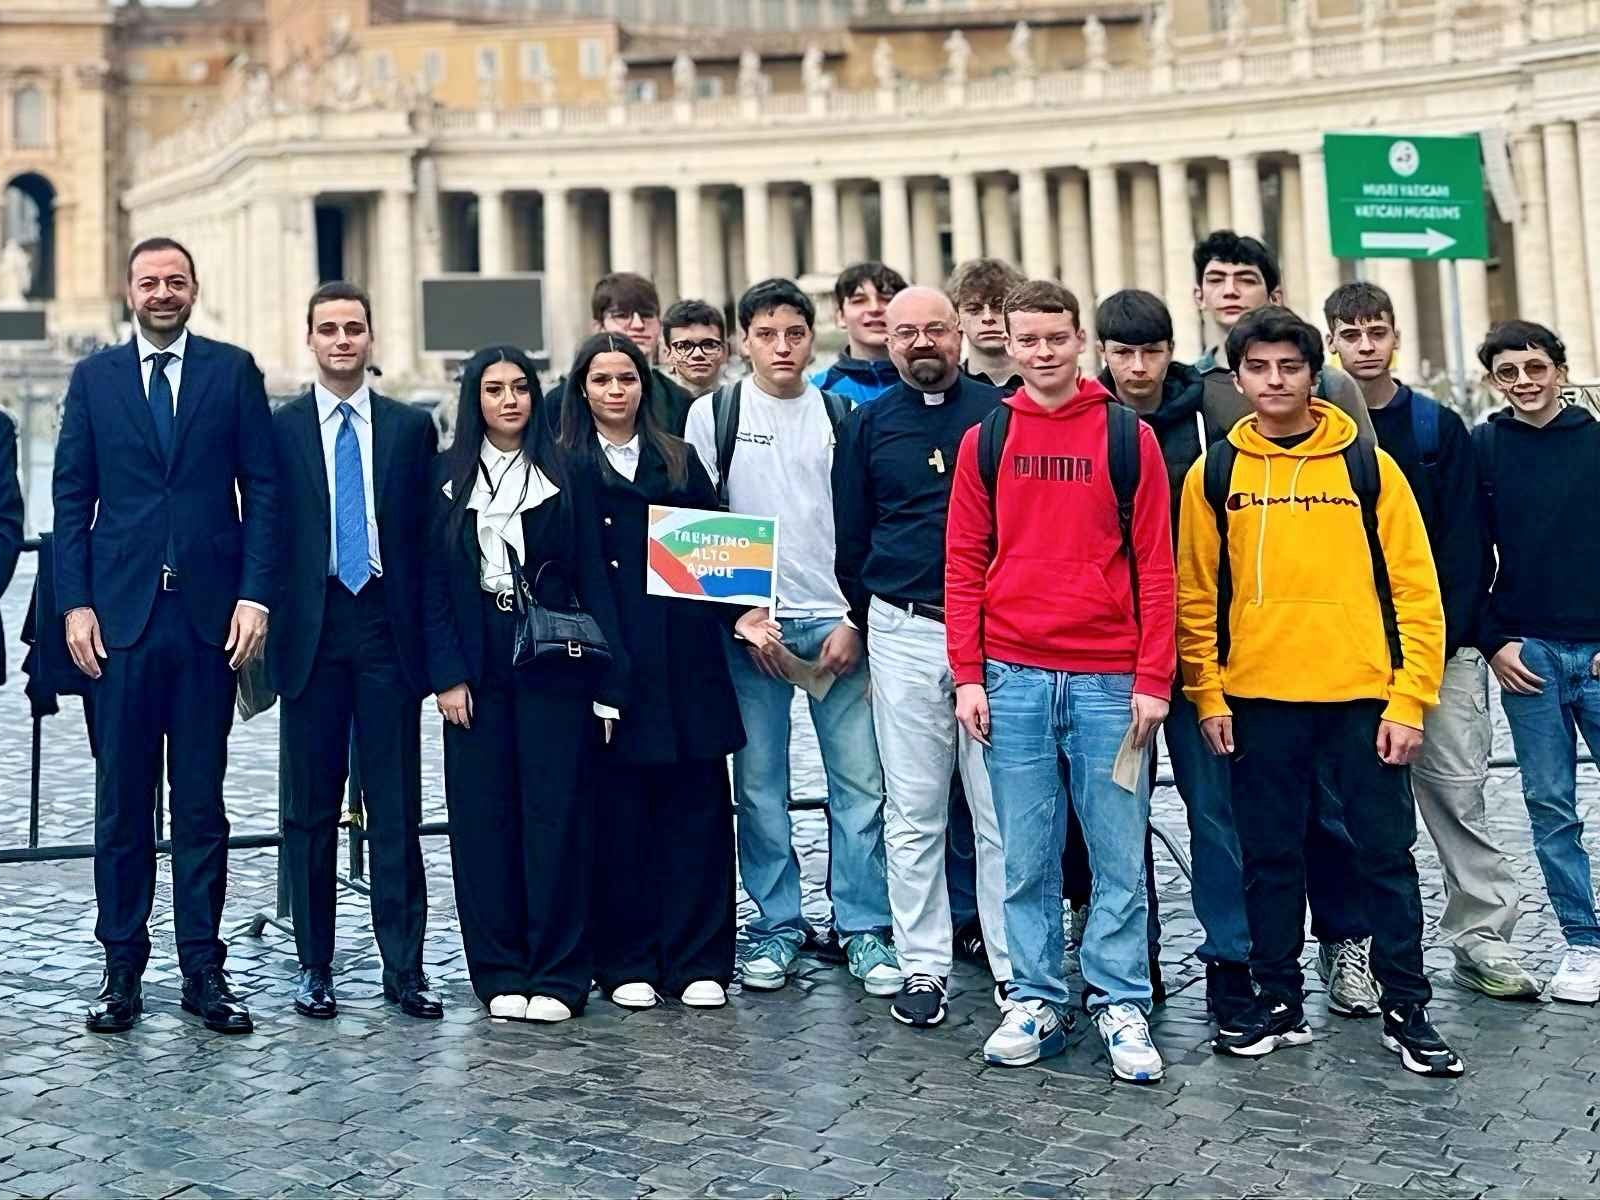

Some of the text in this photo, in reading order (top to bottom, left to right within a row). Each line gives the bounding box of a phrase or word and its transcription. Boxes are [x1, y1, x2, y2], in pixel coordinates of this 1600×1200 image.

[1353, 204, 1403, 218] VATICAN
[1226, 491, 1360, 512] Champion
[672, 529, 751, 549] TRENTINO
[690, 547, 730, 562] ALTO
[686, 562, 735, 579] ADIGE
